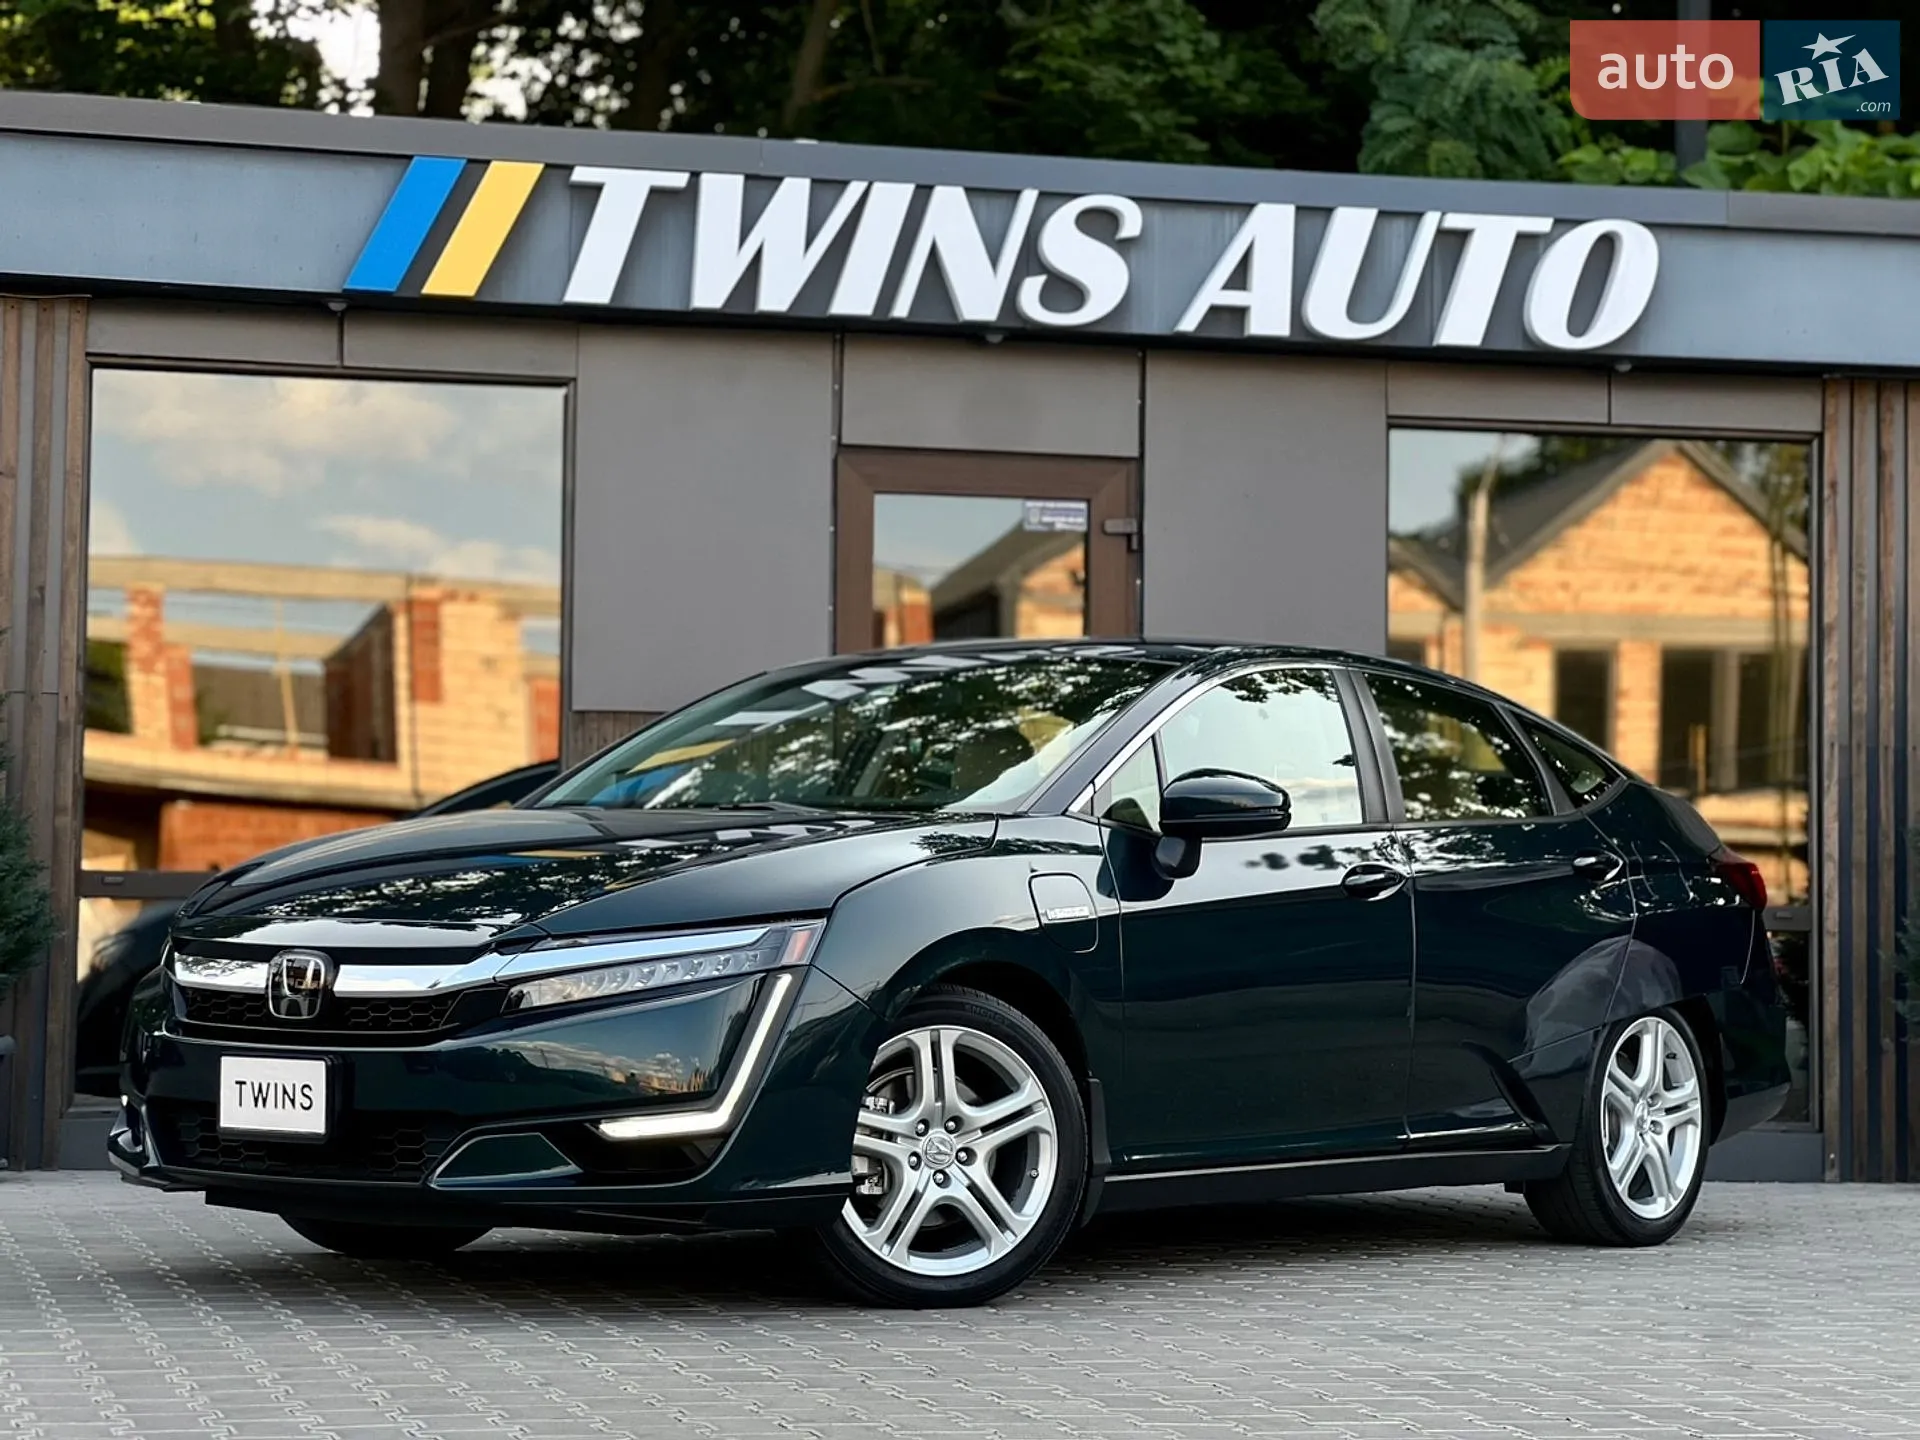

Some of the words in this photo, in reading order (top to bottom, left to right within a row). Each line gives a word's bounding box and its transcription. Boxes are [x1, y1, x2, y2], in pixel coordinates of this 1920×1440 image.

[562, 165, 1143, 327] TWINS
[1173, 202, 1660, 351] AUTO
[235, 1080, 313, 1111] TWINS
